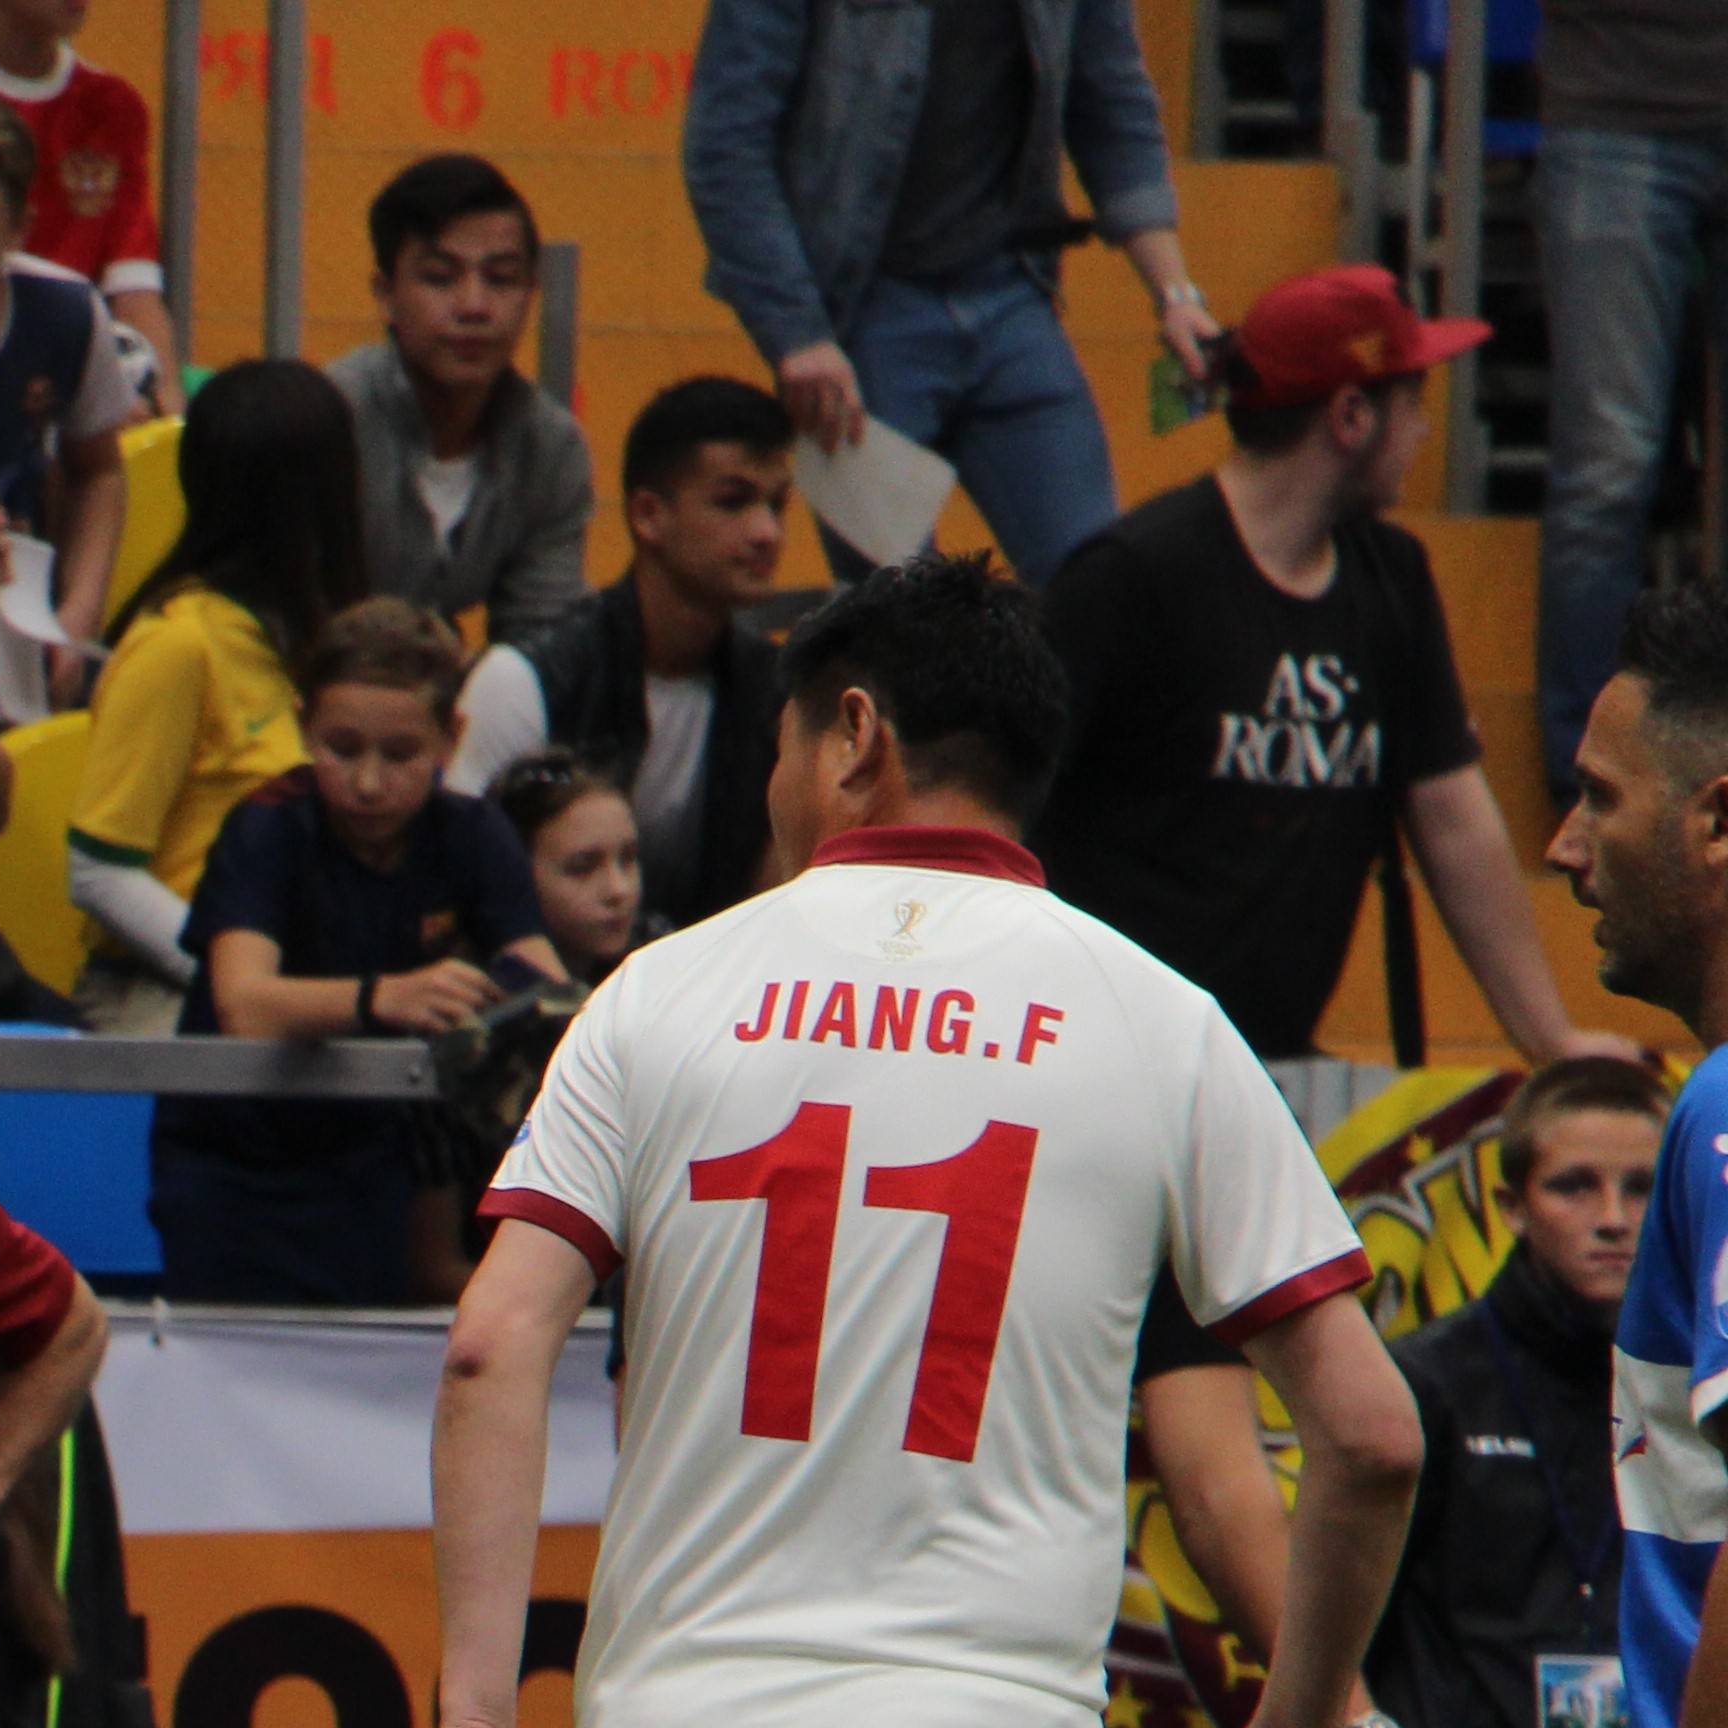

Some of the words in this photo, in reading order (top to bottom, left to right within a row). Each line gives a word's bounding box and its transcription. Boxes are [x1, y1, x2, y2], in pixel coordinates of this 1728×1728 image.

[418, 26, 482, 132] 6
[548, 46, 694, 120] RO
[1212, 712, 1382, 787] ROMA
[734, 979, 1065, 1066] JIANG.F
[689, 1101, 1039, 1463] 11
